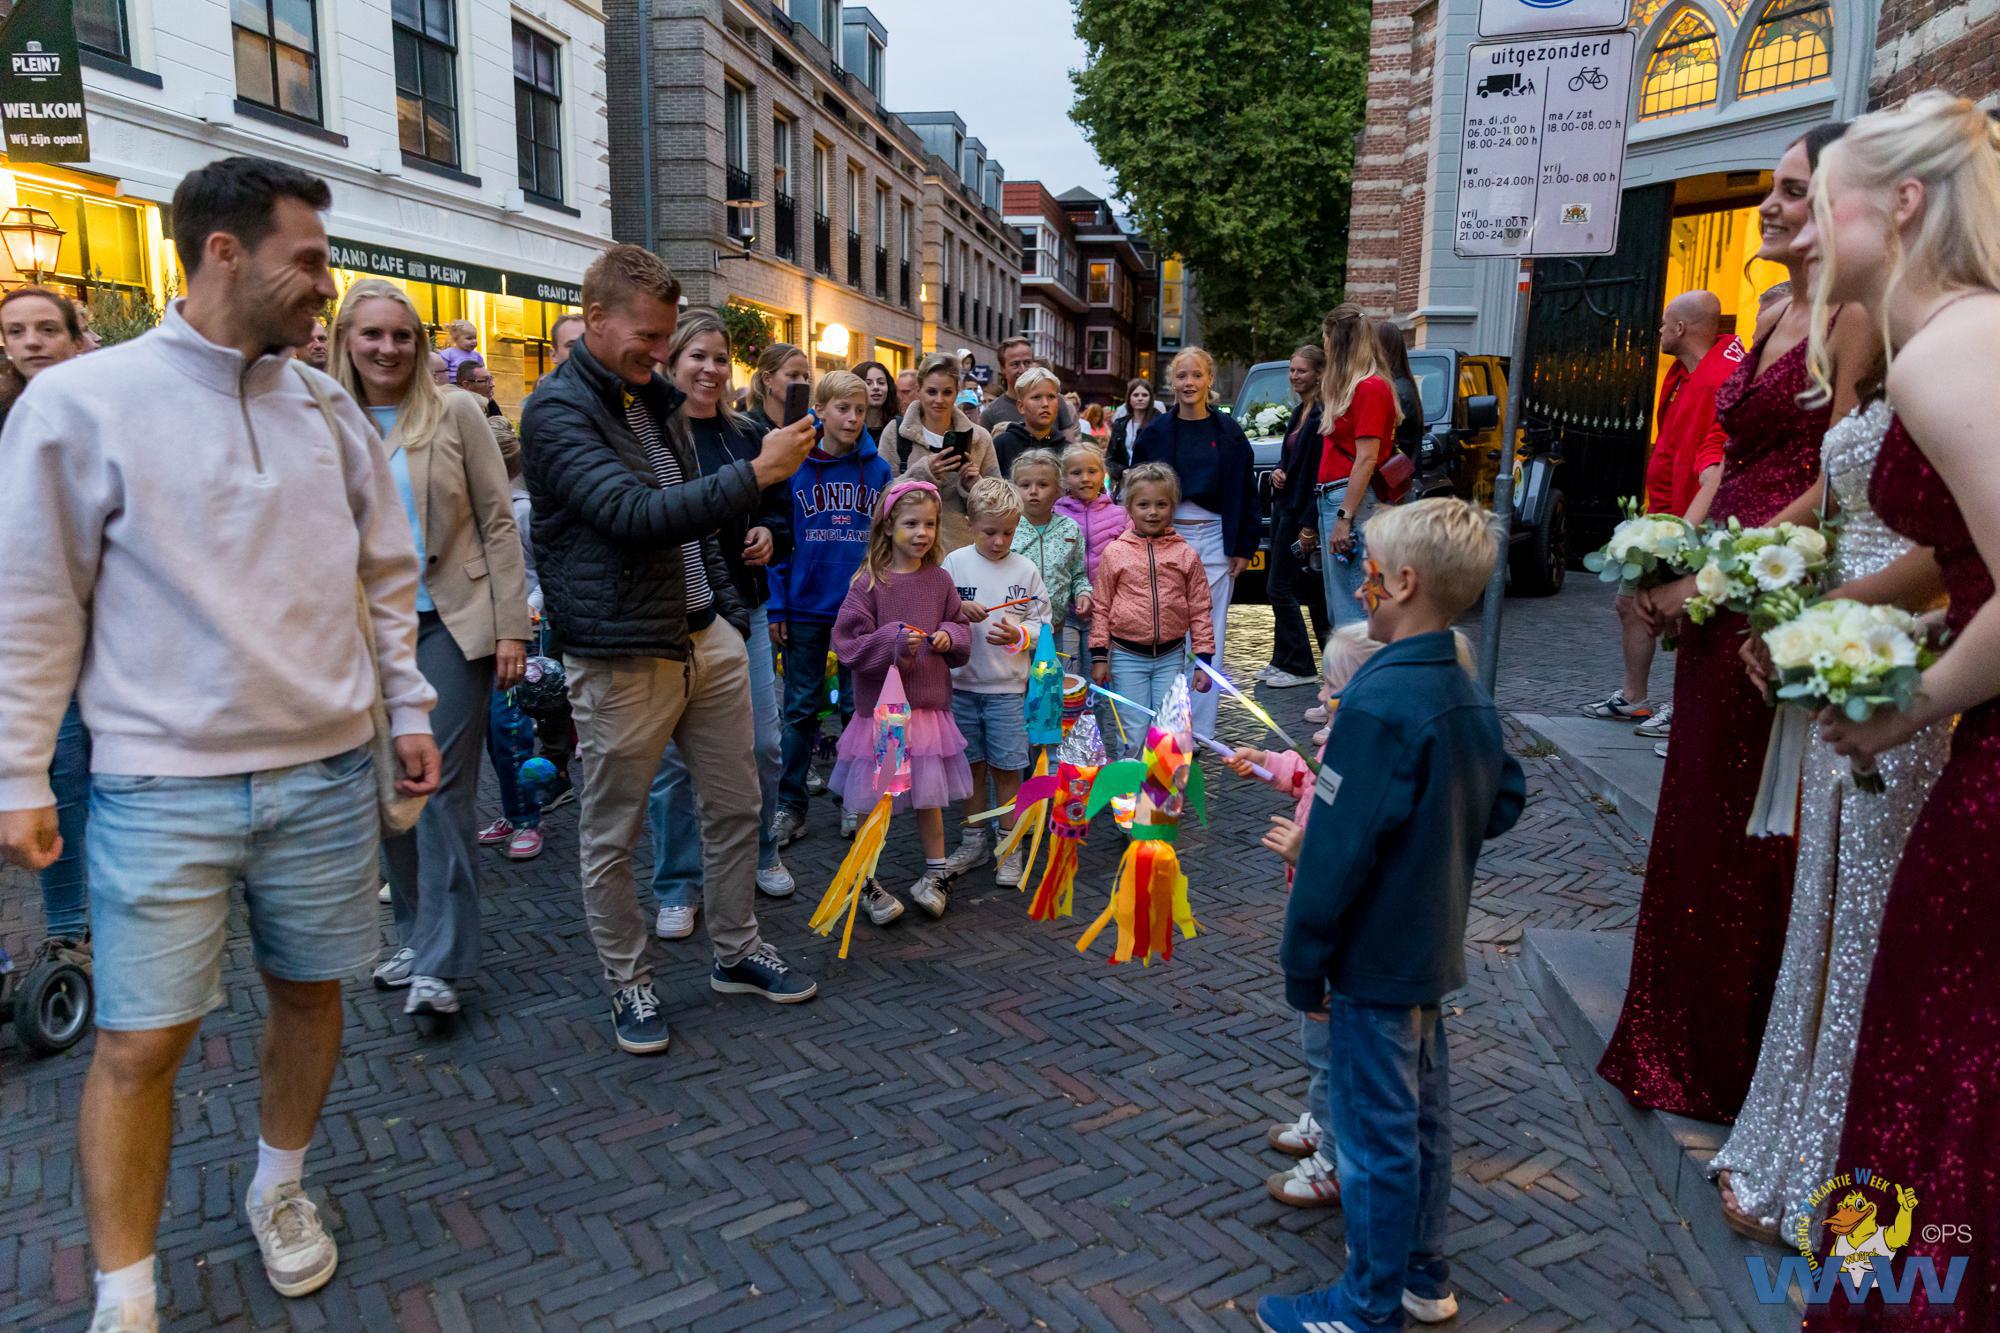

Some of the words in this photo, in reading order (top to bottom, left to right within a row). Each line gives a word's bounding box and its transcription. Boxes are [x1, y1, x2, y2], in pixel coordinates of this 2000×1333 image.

[1492, 39, 1610, 67] uitgezonderd
[12, 57, 60, 72] PLEIN7
[3, 103, 82, 118] WELKOM
[1548, 112, 1563, 121] ma
[1566, 110, 1574, 120] /
[1576, 109, 1592, 120] zat
[1468, 118, 1486, 126] ma.
[1547, 120, 1612, 132] 18.00-08.00
[1615, 120, 1621, 128] h
[1467, 125, 1527, 138] 06.00-11.00
[1529, 124, 1536, 133] h
[9, 133, 29, 147] Wij
[30, 134, 51, 147] zijn
[53, 133, 83, 146] open!
[1467, 136, 1529, 149] 18.00-24.00
[1531, 135, 1538, 145] h
[1466, 167, 1478, 175] wo
[1543, 163, 1561, 175] vrij
[1542, 172, 1606, 185] 21.00-08.00
[1610, 171, 1616, 181] h
[1461, 208, 1478, 220] vrij
[1460, 218, 1519, 230] 06.00-11.00
[1459, 228, 1521, 241] 21.00-24.00
[329, 244, 368, 268] RAND
[371, 253, 405, 275] CAFE
[429, 263, 467, 286] PLEIN7
[537, 283, 567, 301] GRAND
[568, 289, 583, 304] CA
[796, 482, 881, 519] LONDON
[956, 586, 977, 597] REAT
